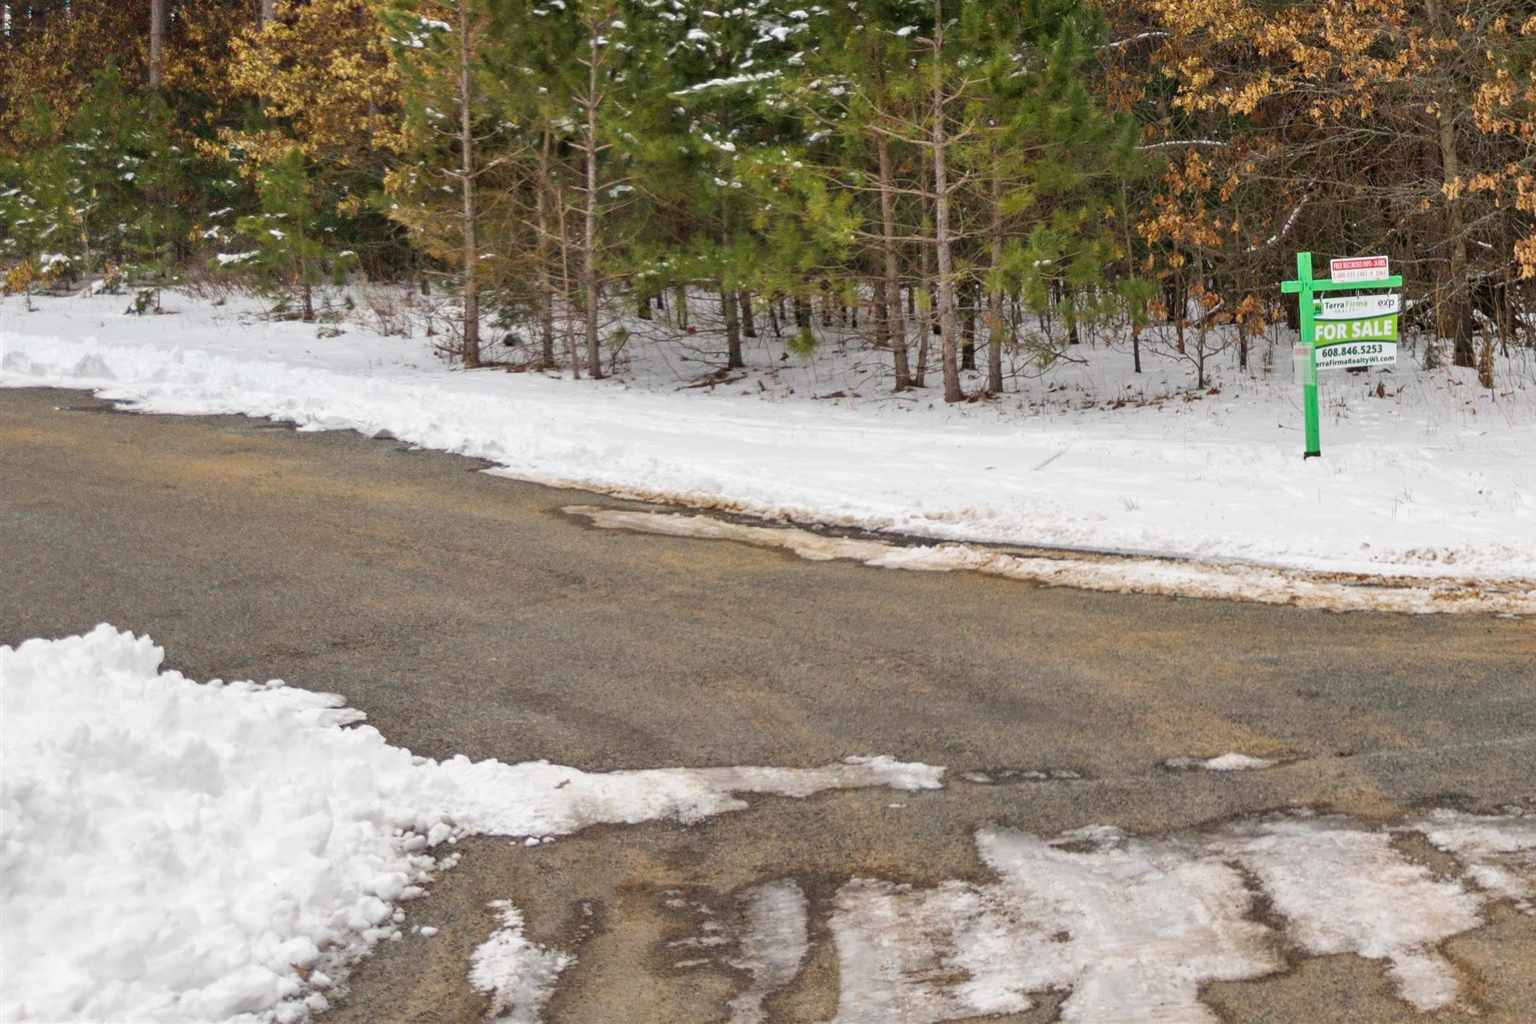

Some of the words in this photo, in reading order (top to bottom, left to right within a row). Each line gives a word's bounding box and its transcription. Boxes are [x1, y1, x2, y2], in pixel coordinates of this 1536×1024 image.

[1377, 298, 1395, 308] exp
[1315, 323, 1348, 341] FOR
[1351, 319, 1392, 338] SALE
[1322, 344, 1383, 357] 608.846.5253
[1316, 356, 1395, 368] erraFirmaRealtyWI.com
